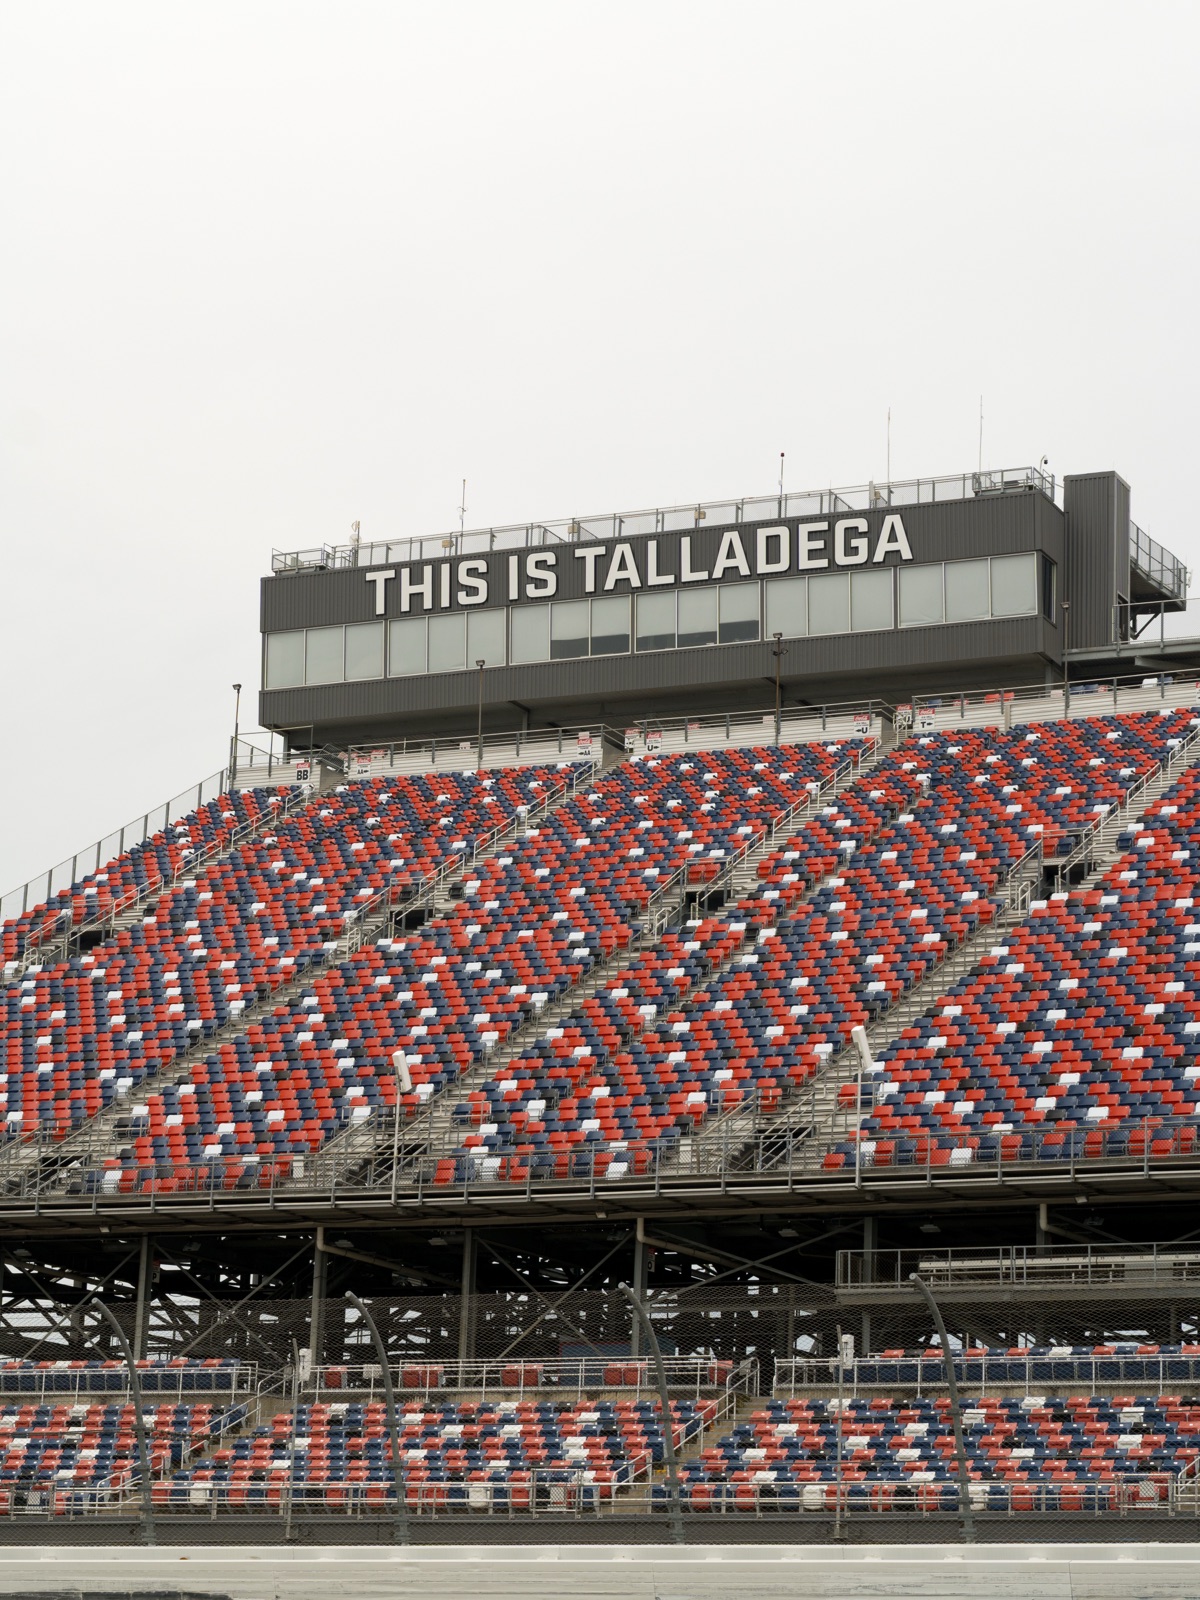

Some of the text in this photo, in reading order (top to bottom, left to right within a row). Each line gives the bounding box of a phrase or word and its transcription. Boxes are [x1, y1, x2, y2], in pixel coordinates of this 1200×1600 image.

[366, 514, 913, 615] THIS IS TALLADEGA
[296, 769, 309, 780] BB
